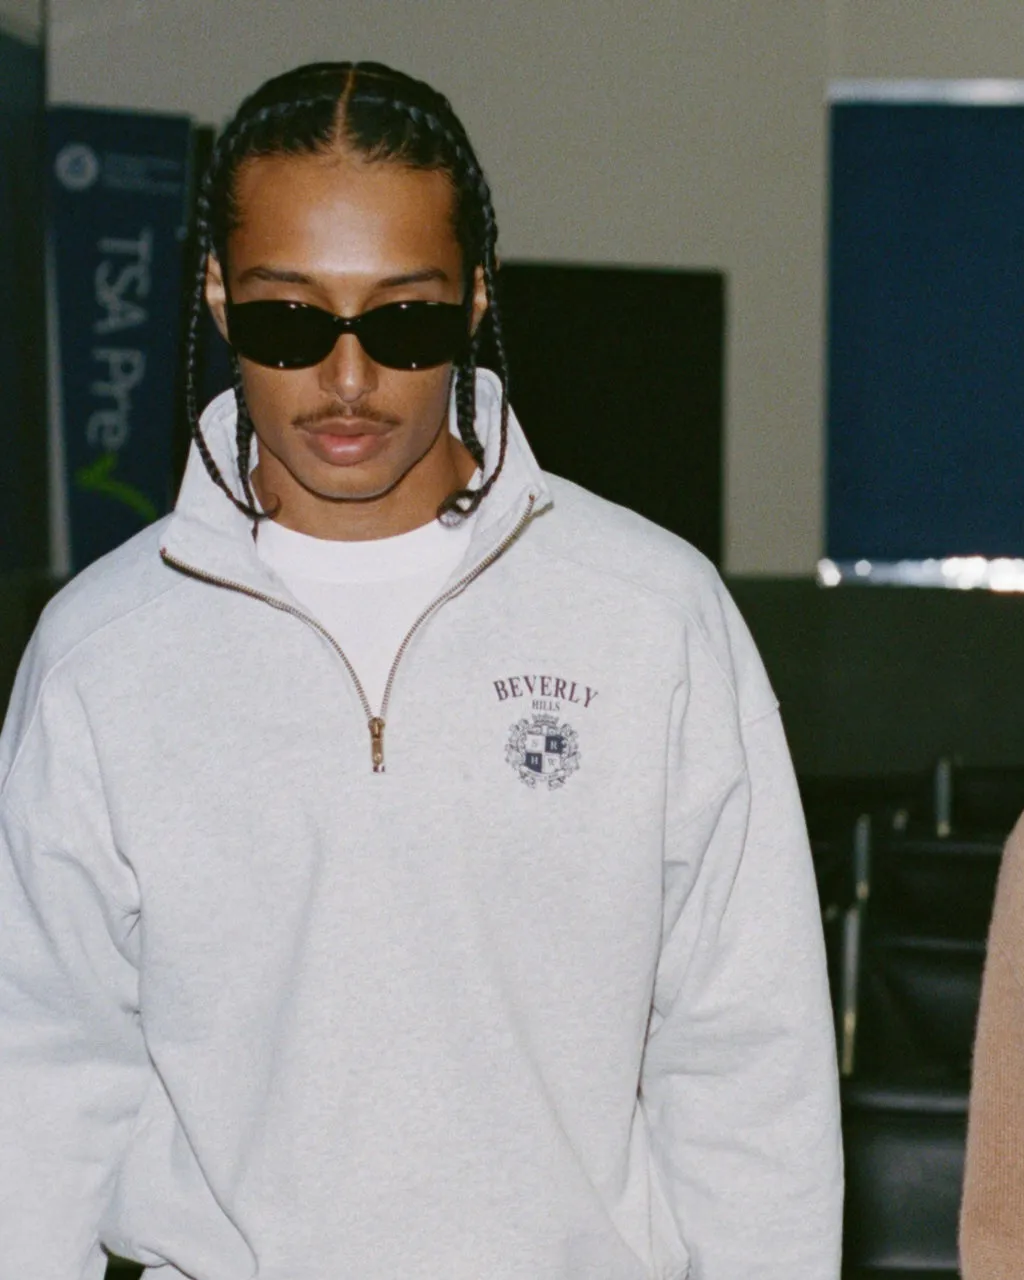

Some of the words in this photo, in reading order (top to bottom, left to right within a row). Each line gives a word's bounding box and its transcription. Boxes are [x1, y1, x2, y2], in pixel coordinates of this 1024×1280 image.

[94, 224, 154, 336] TSA
[86, 347, 146, 453] Pre
[492, 674, 599, 709] BEVERLY
[531, 699, 561, 712] HILLS
